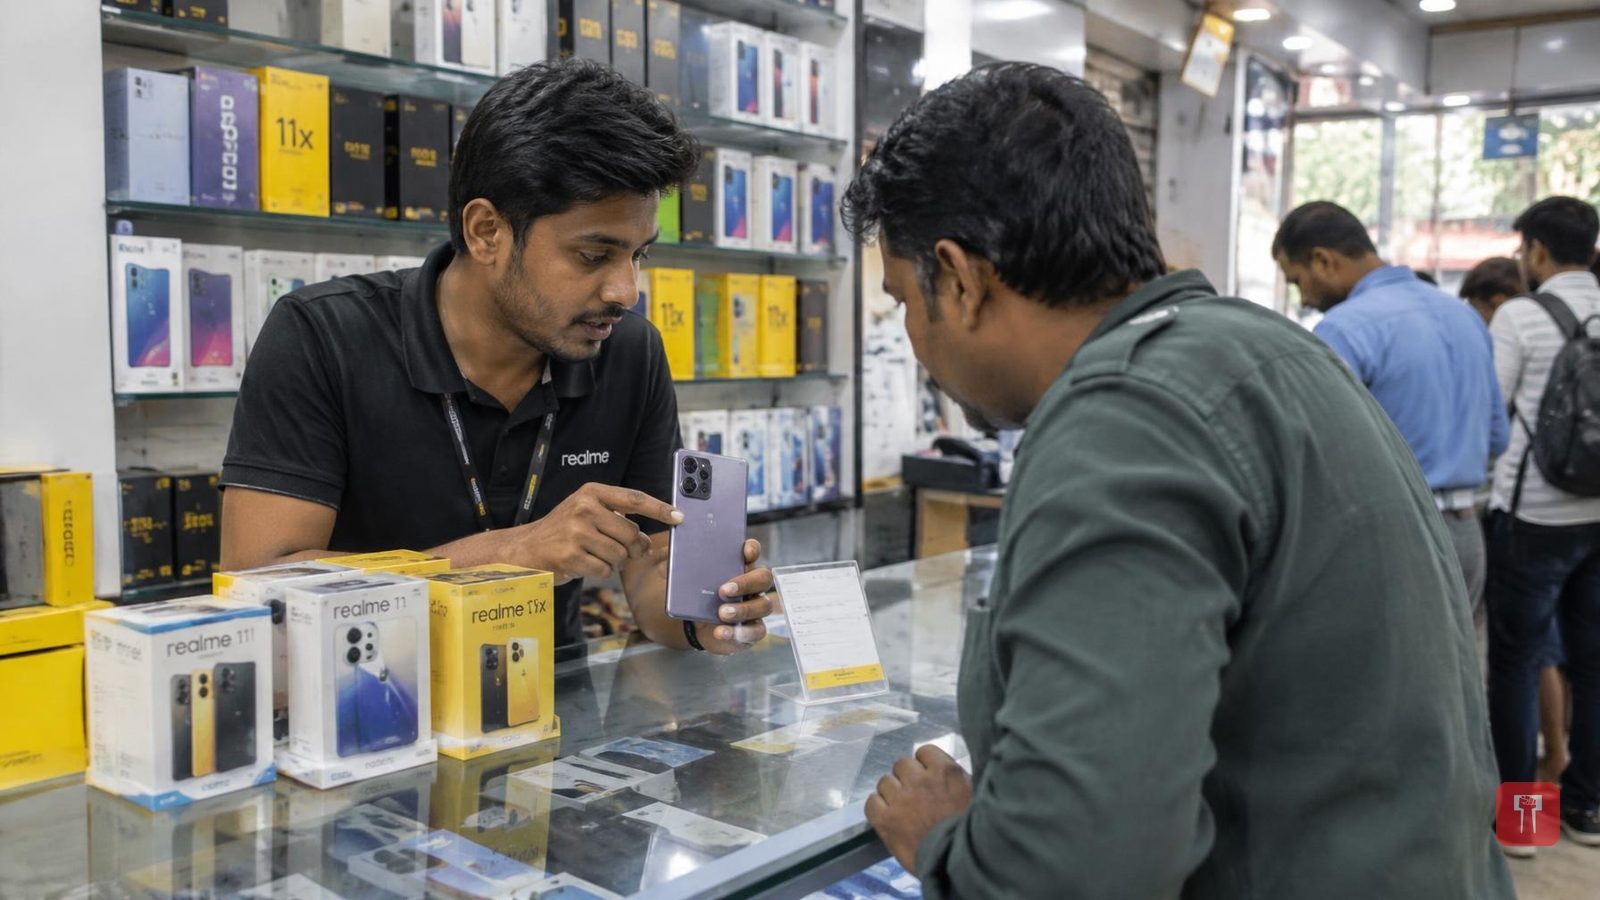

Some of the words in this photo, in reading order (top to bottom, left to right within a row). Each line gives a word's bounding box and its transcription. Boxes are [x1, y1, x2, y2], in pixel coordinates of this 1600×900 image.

[276, 117, 314, 150] 11x
[561, 449, 610, 466] realme
[332, 599, 391, 620] realme
[394, 596, 407, 610] 11
[471, 602, 525, 624] realme
[166, 634, 232, 657] realme
